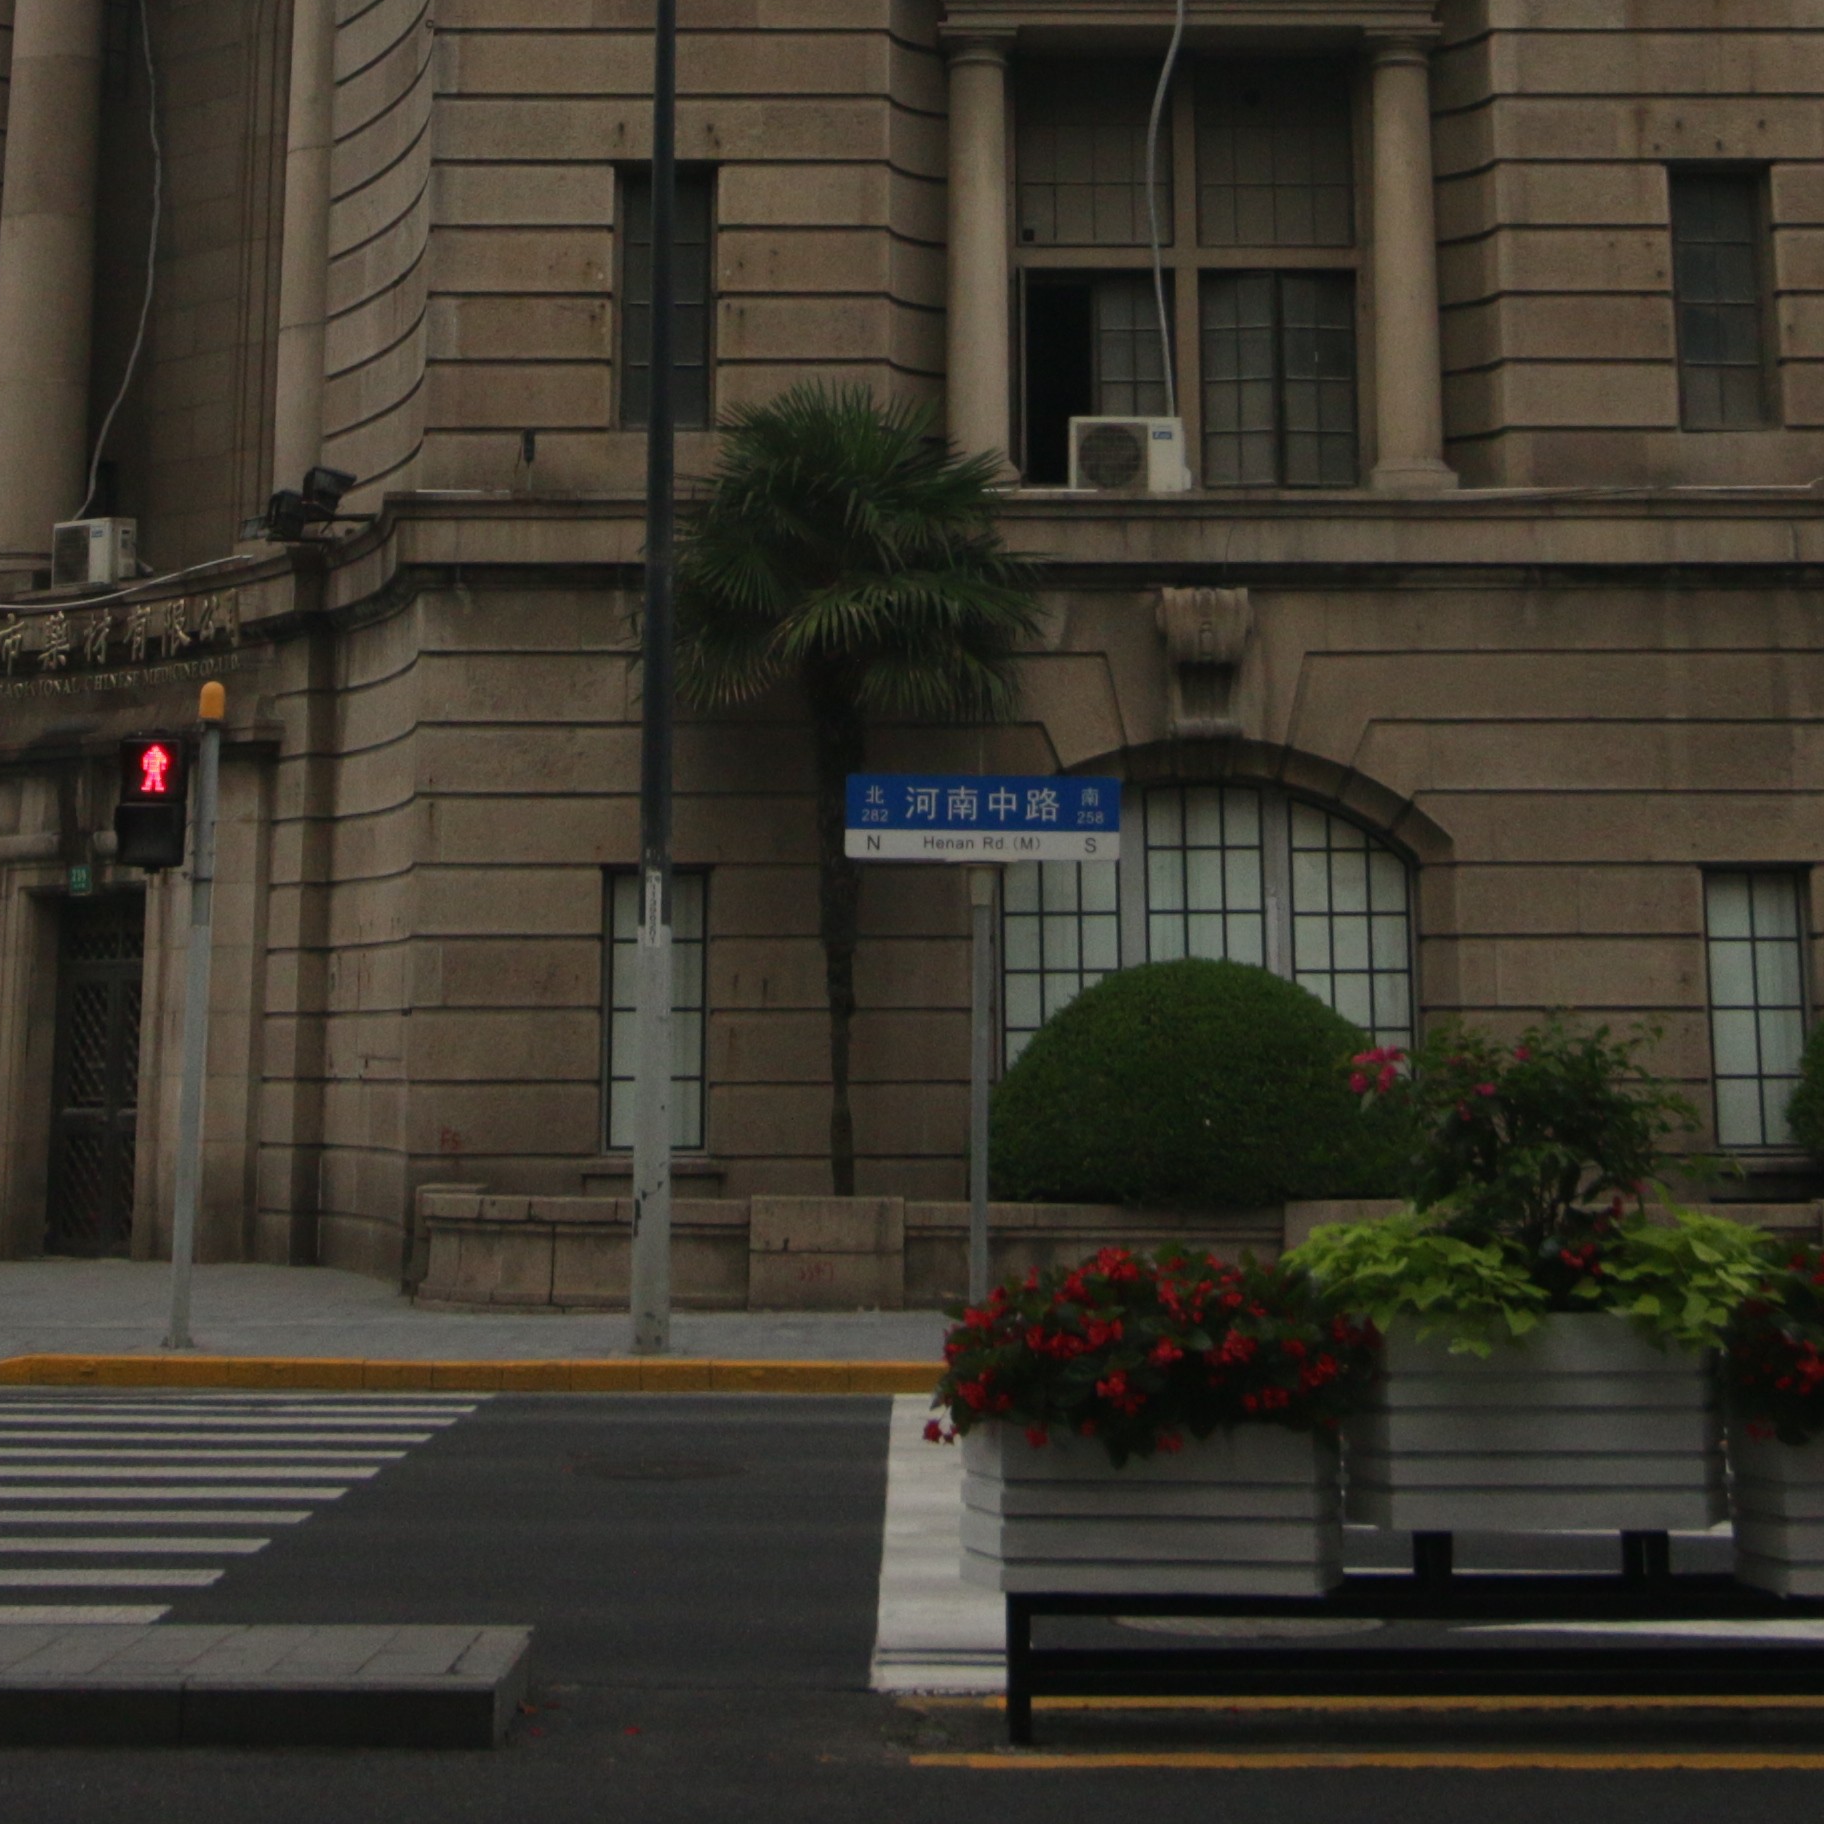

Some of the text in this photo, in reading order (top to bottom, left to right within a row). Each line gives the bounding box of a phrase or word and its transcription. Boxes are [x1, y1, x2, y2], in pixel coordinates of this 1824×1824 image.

[83, 669, 140, 692] CHINESE
[143, 661, 198, 686] MEDICINE
[864, 785, 1100, 822] 北 河南中路 南
[861, 809, 1105, 825] 282 258
[866, 835, 881, 851] N
[923, 836, 975, 851] Henan
[1084, 837, 1097, 854] S
